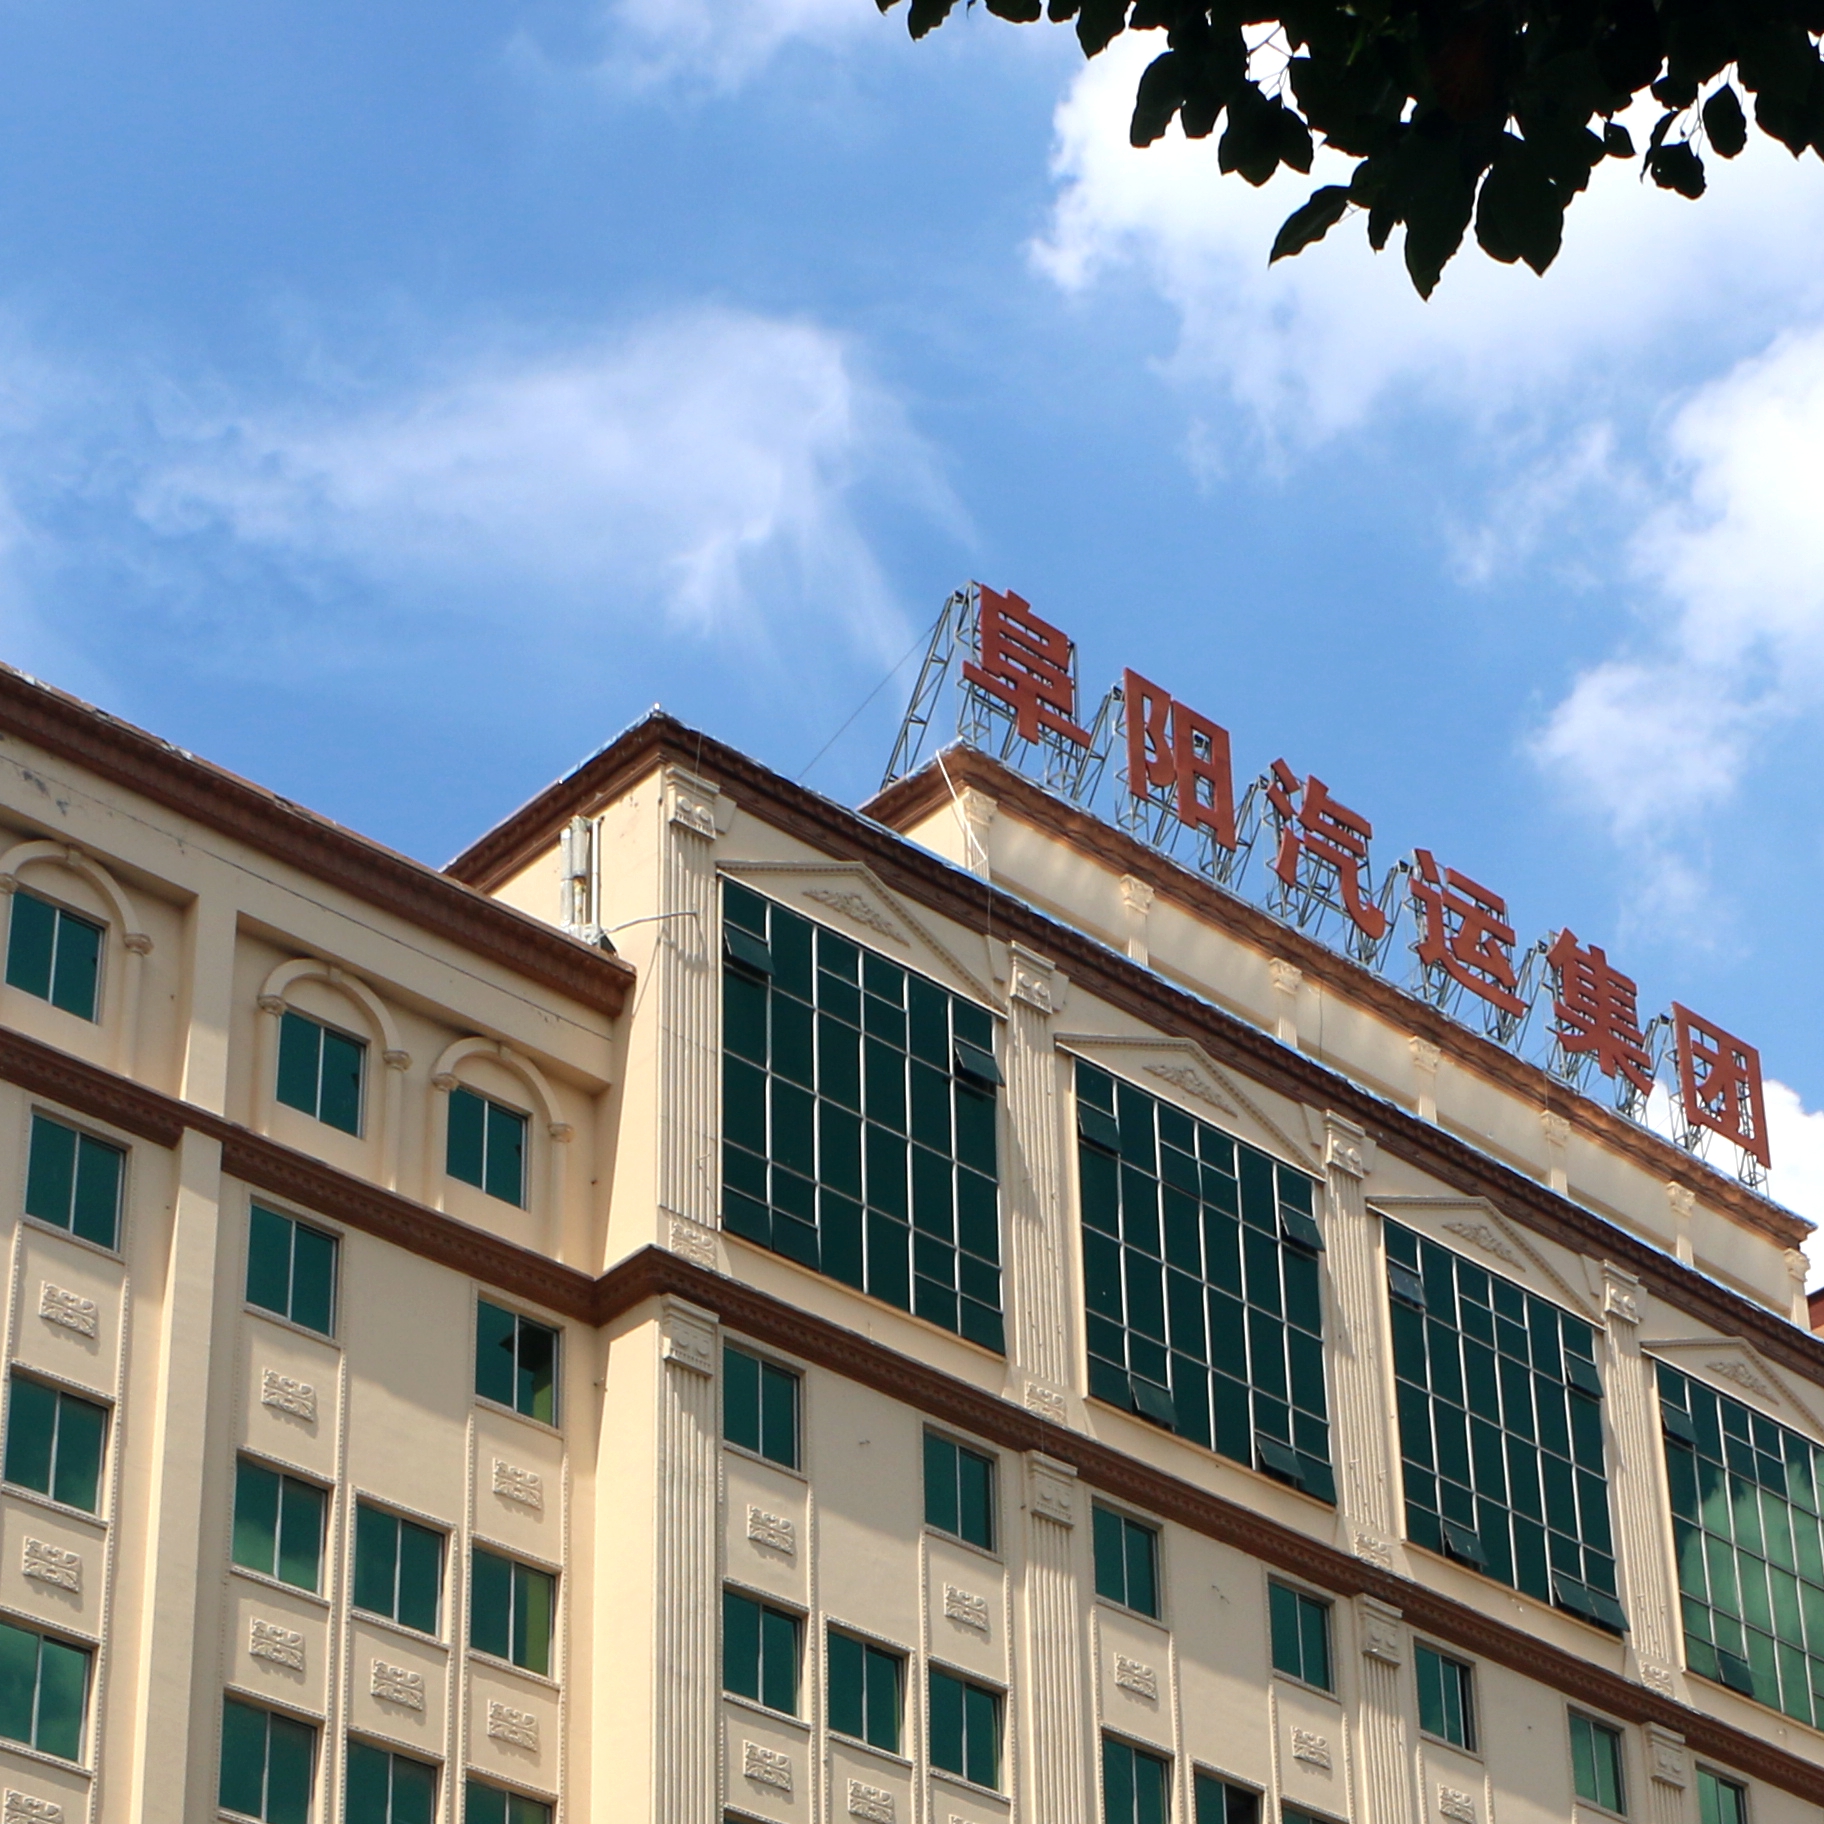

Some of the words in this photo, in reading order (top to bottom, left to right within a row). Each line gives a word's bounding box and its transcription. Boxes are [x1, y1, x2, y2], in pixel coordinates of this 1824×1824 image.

[963, 582, 1771, 1169] 阜阳汽运集团
